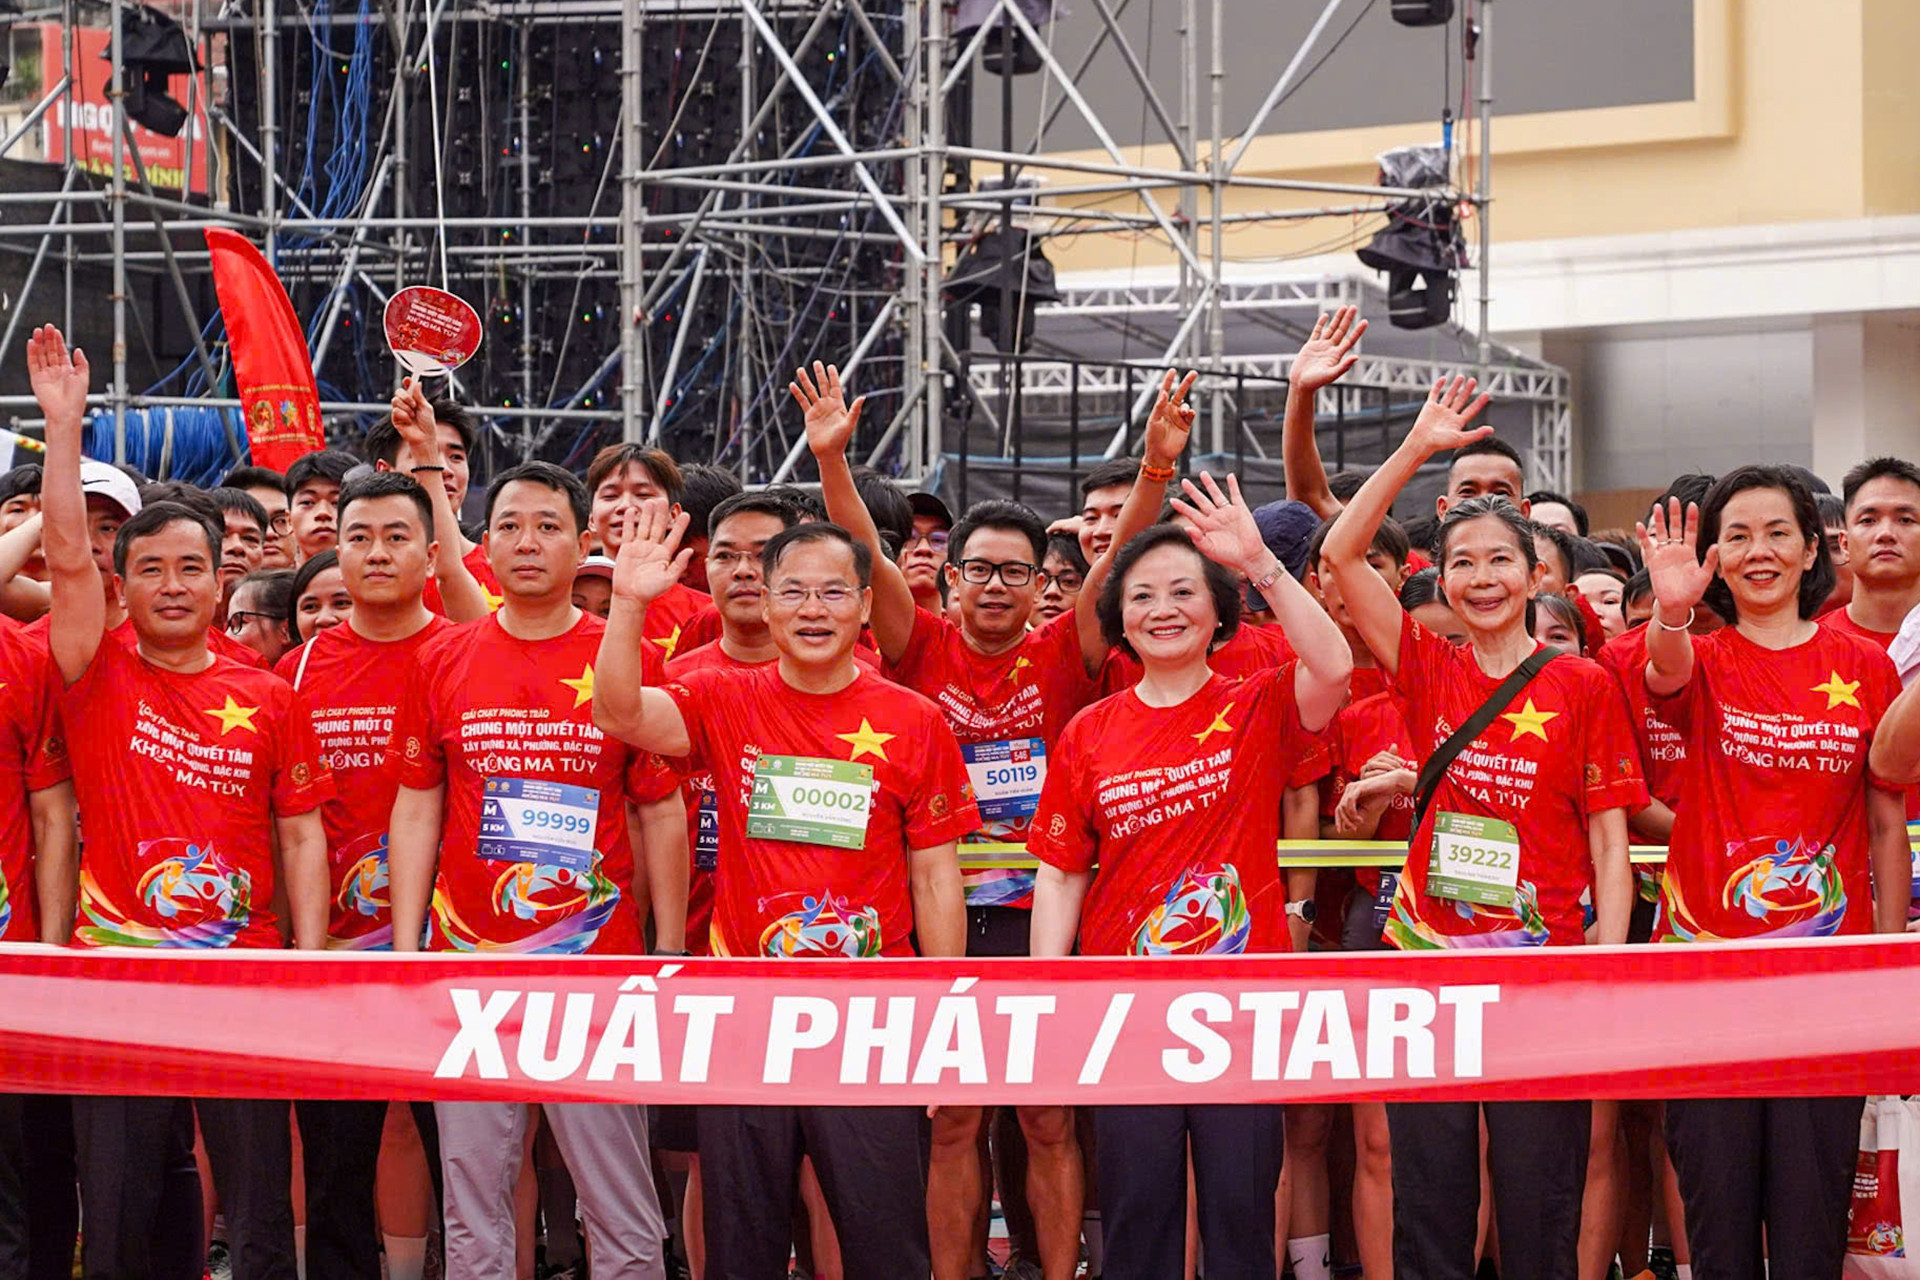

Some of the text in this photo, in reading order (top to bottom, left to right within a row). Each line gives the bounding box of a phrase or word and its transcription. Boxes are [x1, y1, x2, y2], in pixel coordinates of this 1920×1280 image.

[499, 708, 529, 720] PHONG
[528, 708, 550, 719] TRÀO
[353, 717, 382, 734] MỘT
[461, 719, 604, 741] CHUNG MỘT QUYẾT TÂM
[1790, 721, 1830, 739] QUYẾT
[1832, 723, 1859, 739] TÂM
[186, 743, 226, 762] QUYẾT
[226, 747, 253, 765] TÂM
[563, 741, 582, 754] ĐẶC
[583, 743, 602, 755] KHU
[466, 751, 598, 775] KHÔNG MA TÚY
[1473, 753, 1508, 771] QUYẾT
[1509, 756, 1538, 775] TÂM
[1778, 756, 1811, 770] MA
[1816, 755, 1853, 774] TÚY
[176, 769, 246, 798] MA TÚY
[986, 765, 1037, 786] 50119
[1099, 783, 1139, 805] CHUNG
[1167, 758, 1205, 783] QUYẾT
[1514, 777, 1534, 790] KHU
[754, 783, 769, 794] M
[760, 802, 776, 811] KM
[792, 787, 866, 812] 00002
[483, 804, 497, 816] M
[1110, 807, 1164, 840] KHÔNG
[1165, 799, 1195, 819] MA
[490, 824, 505, 832] KM
[521, 809, 591, 835] 99999
[700, 818, 712, 829] M
[1447, 844, 1512, 869] 39222
[1381, 879, 1390, 888] F
[433, 964, 1500, 1085] XUẤT PHÁT / START
